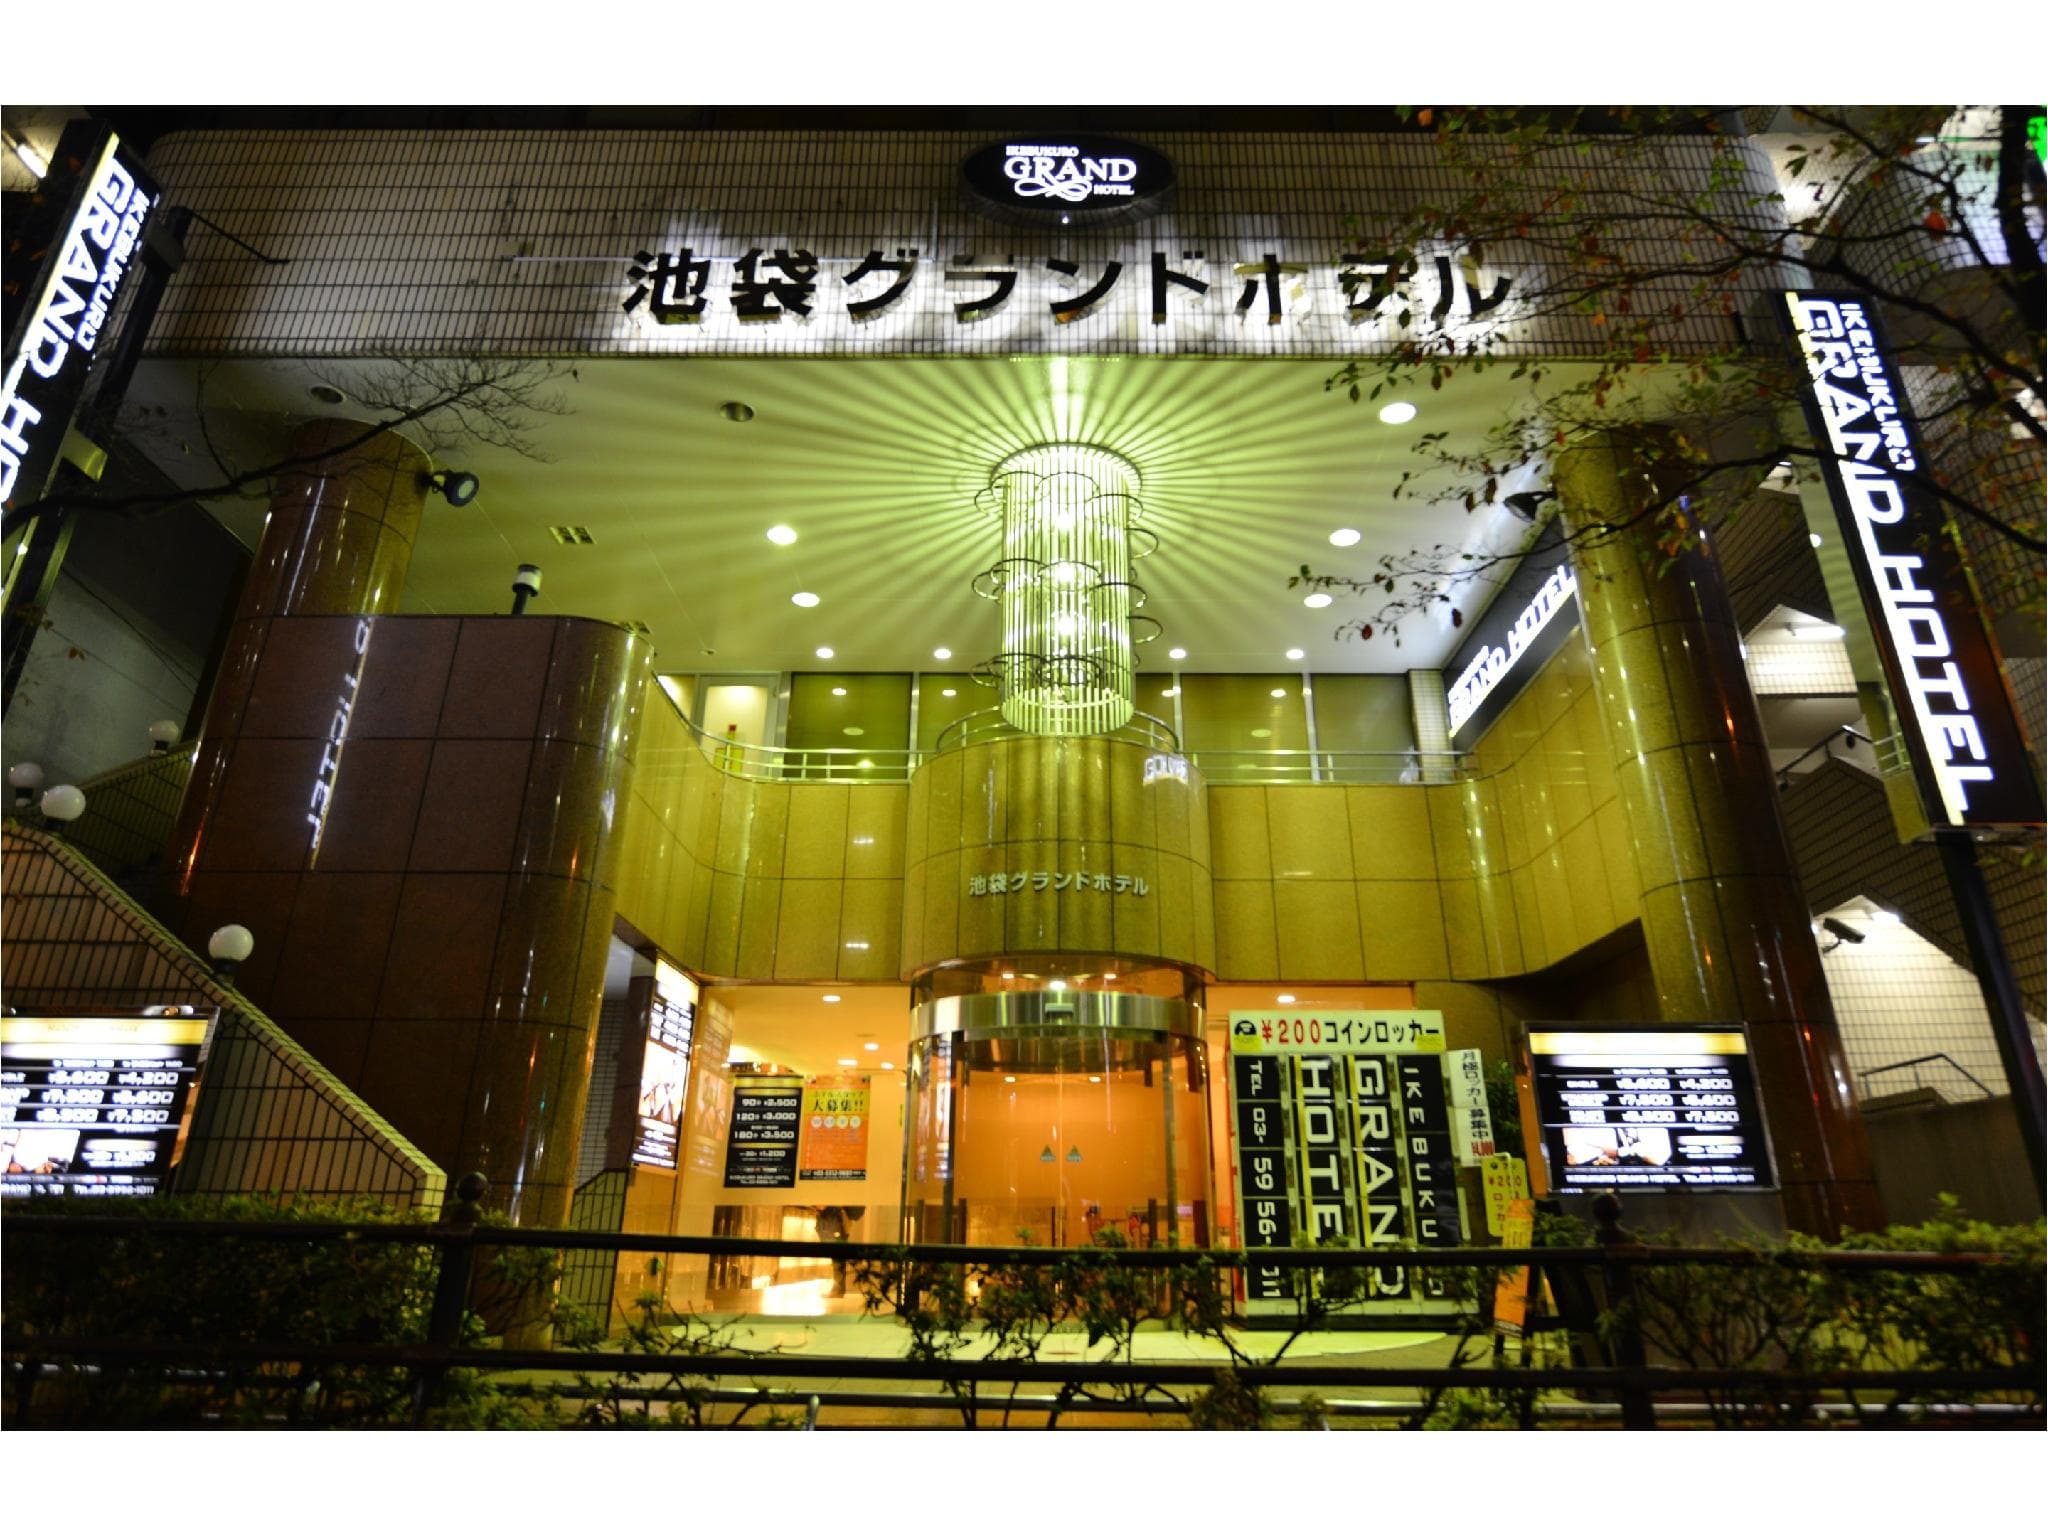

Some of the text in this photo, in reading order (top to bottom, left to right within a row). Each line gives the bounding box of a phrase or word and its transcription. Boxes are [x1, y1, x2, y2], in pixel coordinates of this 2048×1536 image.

[1003, 156, 1138, 183] GRAND
[1093, 184, 1136, 196] HOTEL
[26, 157, 135, 379] GRAND
[73, 186, 150, 352] IKEBUKURO
[622, 247, 1514, 326] 池袋グランドホテル
[1506, 564, 1578, 660] HOTEL
[1872, 555, 1994, 812] HOTEL
[969, 869, 1149, 897] 池袋グランドホテル
[1249, 1060, 1264, 1096] TEL
[1300, 1059, 1346, 1252] HOTE
[1403, 1067, 1445, 1296] IKEBUKUO
